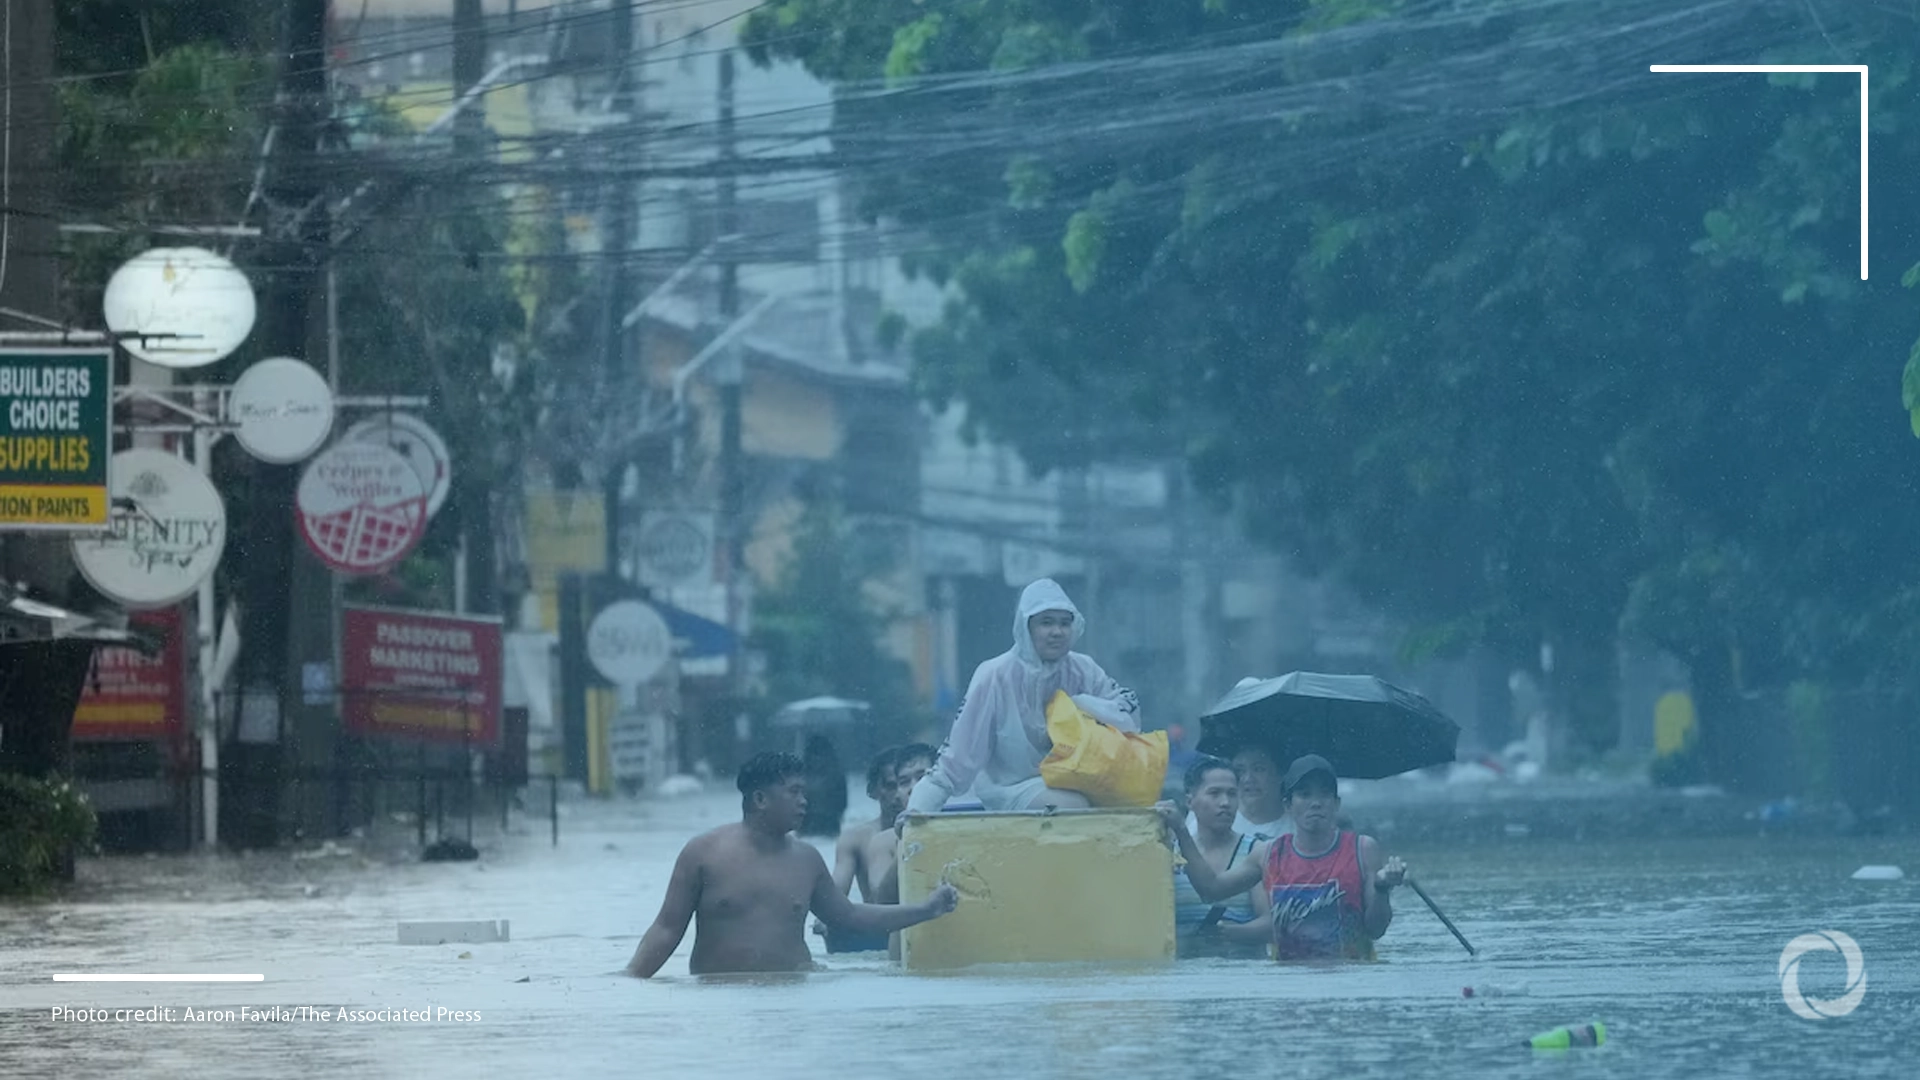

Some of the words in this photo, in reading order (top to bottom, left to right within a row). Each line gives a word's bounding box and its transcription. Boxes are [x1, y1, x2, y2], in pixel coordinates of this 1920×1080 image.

[1, 367, 91, 397] BUILDERS
[9, 400, 80, 430] CHOICE
[0, 436, 90, 472] SUPPLIES
[37, 497, 90, 518] PAINTS
[376, 622, 473, 650] PASSOVER
[370, 646, 480, 676] MARKETING
